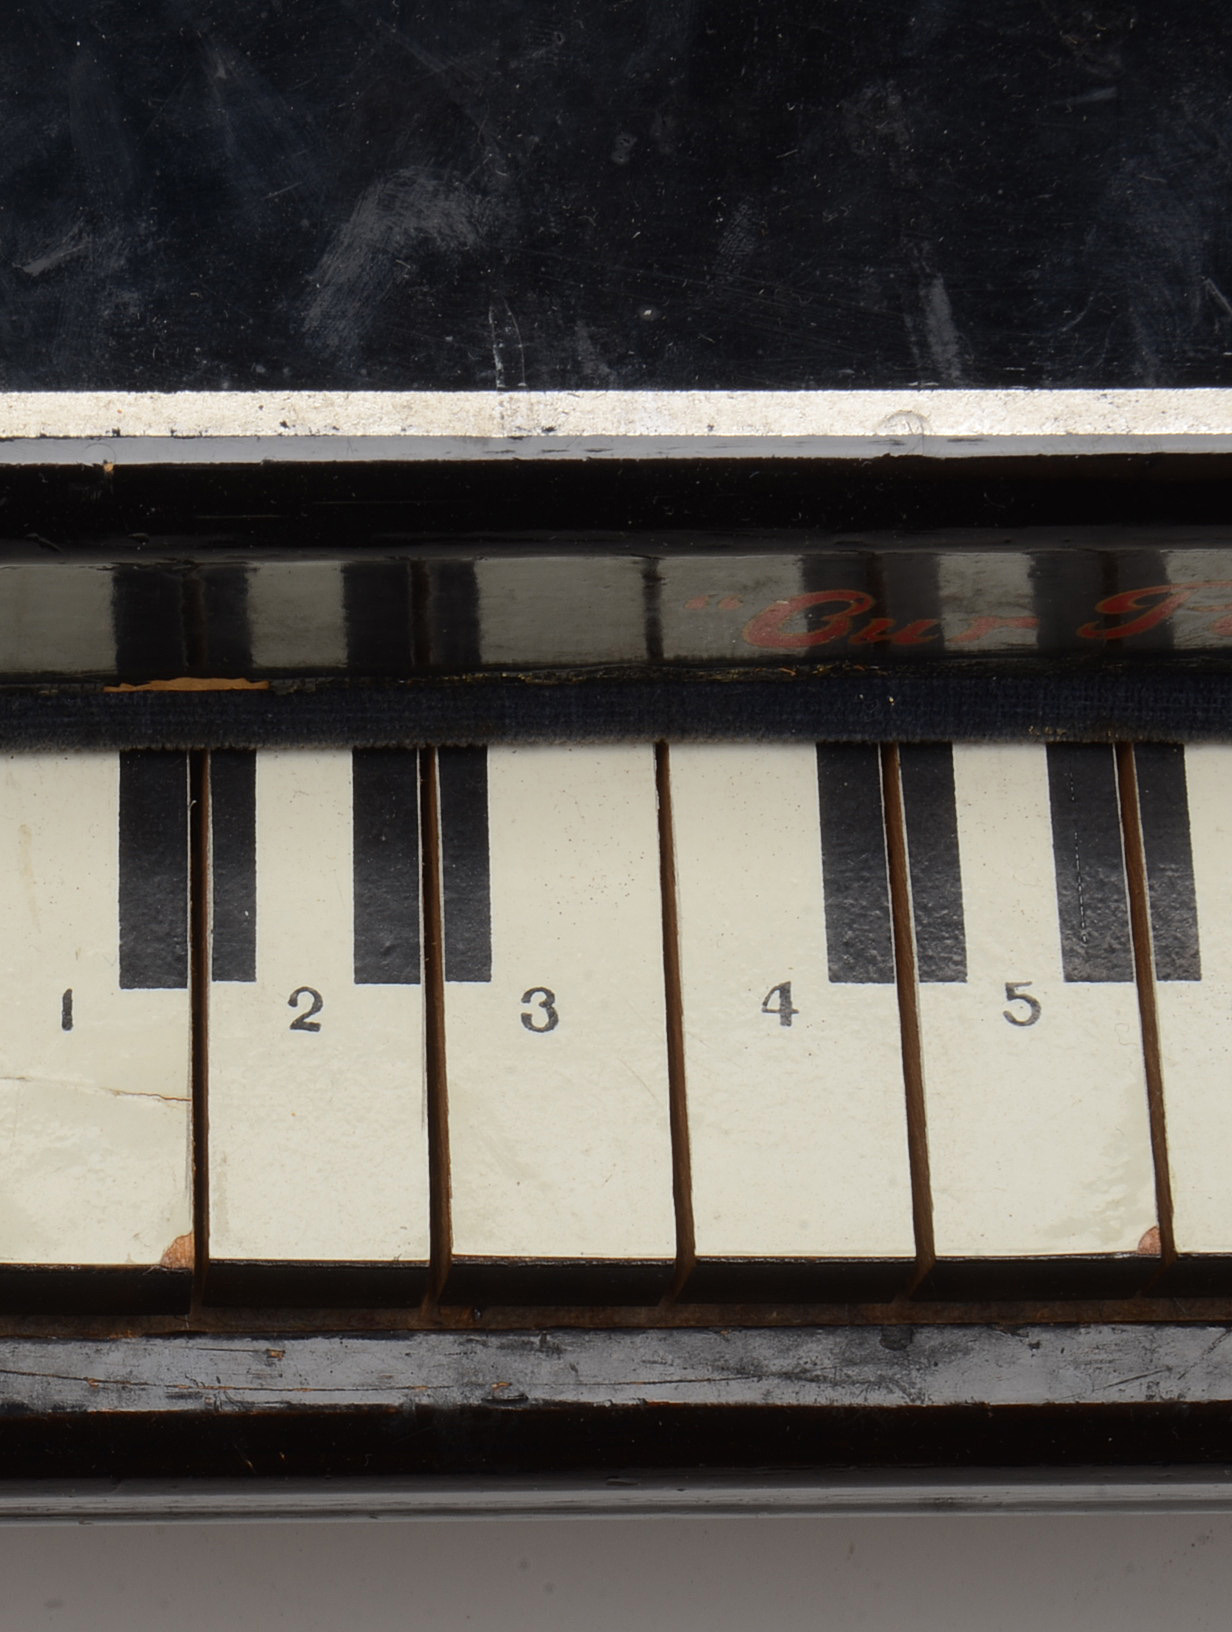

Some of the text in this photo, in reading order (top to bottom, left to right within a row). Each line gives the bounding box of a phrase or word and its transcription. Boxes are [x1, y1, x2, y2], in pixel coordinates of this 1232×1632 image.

[61, 988, 74, 1031] 1
[287, 986, 323, 1033] 2
[520, 986, 559, 1033] 3
[762, 981, 800, 1027] 4
[1003, 982, 1042, 1027] 5
